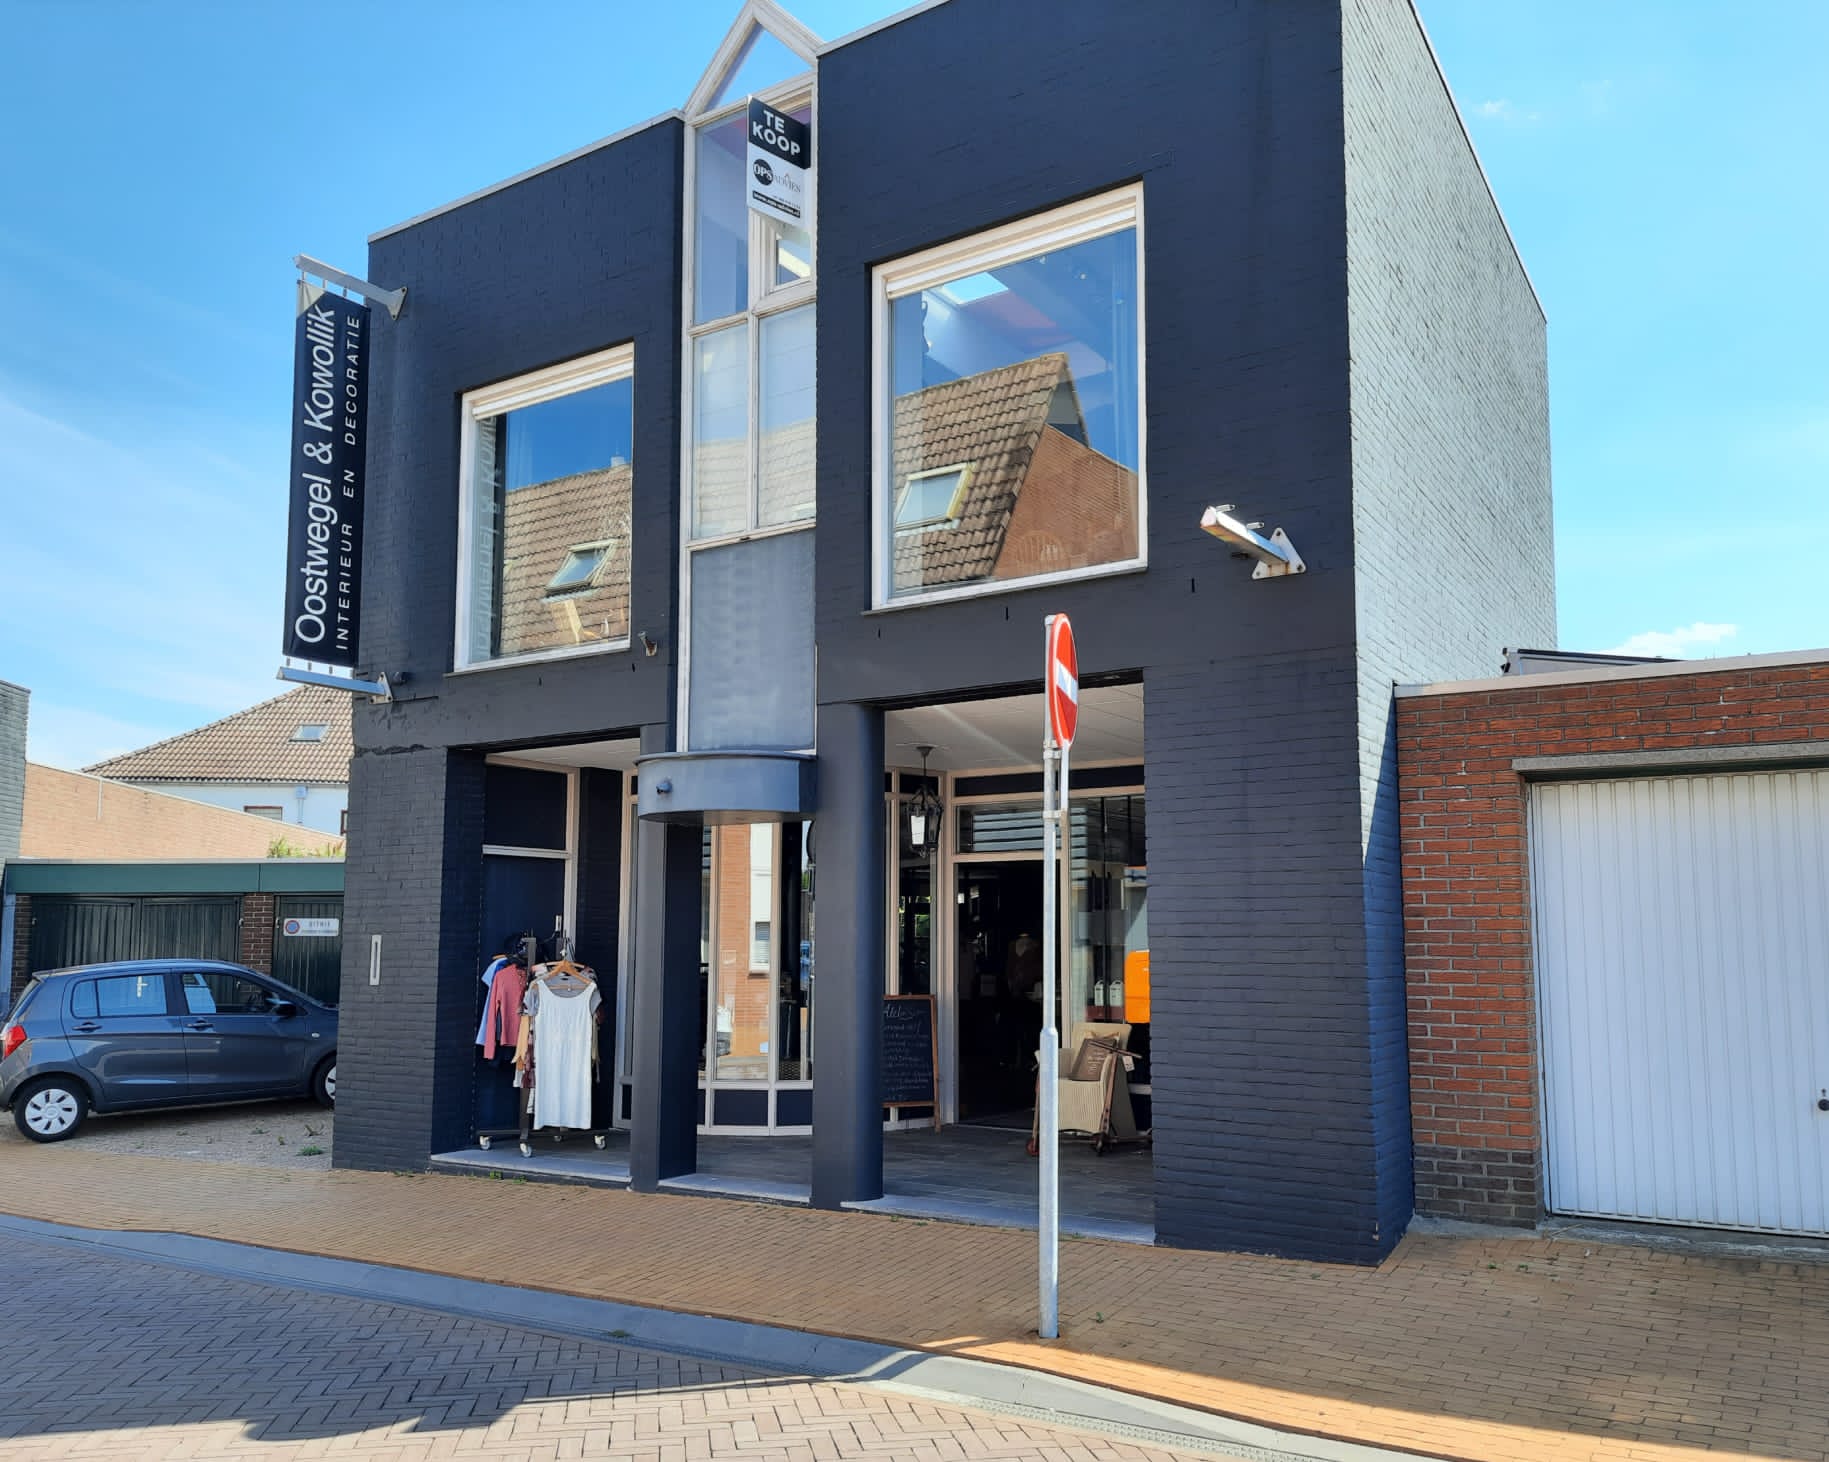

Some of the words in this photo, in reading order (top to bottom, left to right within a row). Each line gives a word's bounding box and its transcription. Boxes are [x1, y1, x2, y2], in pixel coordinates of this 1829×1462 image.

[752, 121, 800, 156] KOOP
[763, 109, 785, 134] TE
[303, 304, 335, 432] Kowollik
[344, 316, 360, 446] DECORATIE
[303, 442, 333, 465] &
[342, 469, 355, 498] EN
[294, 472, 338, 643] Oostwegel
[335, 524, 353, 650] INTERIEUR
